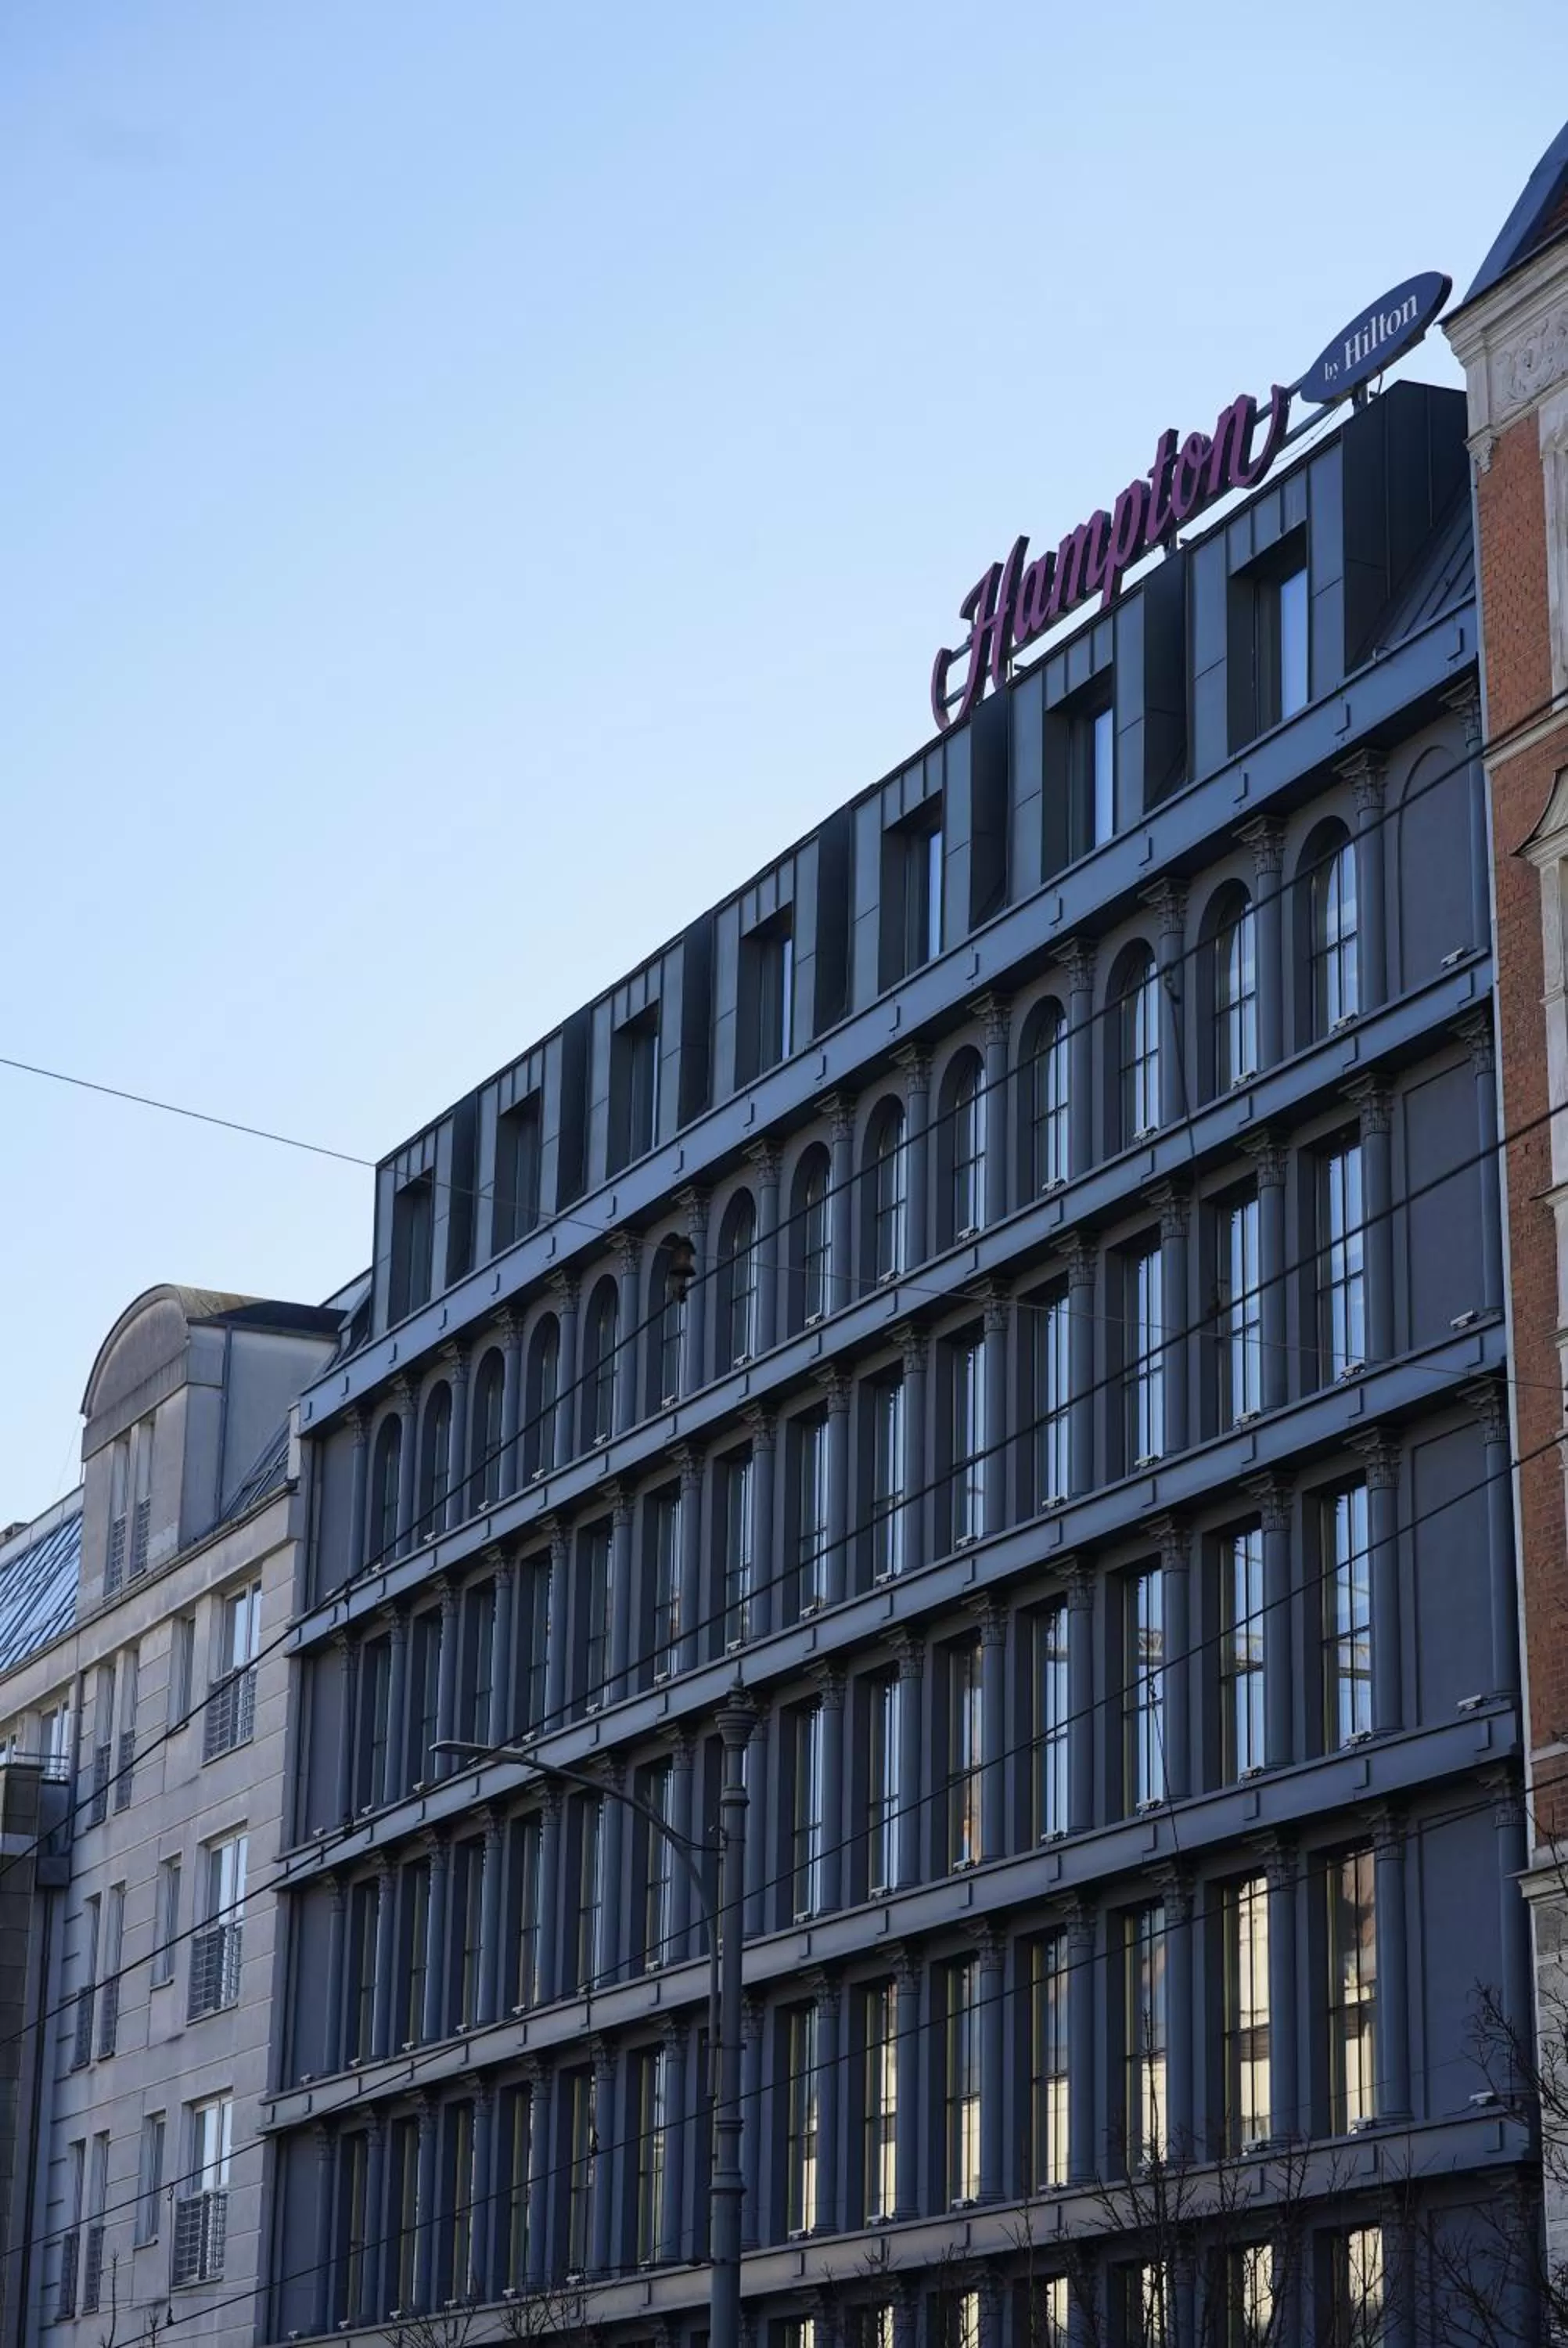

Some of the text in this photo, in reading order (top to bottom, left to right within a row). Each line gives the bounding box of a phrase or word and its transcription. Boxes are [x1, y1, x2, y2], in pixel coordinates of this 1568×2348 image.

[1324, 294, 1418, 381] by Hilton
[931, 384, 1289, 733] Hampton
